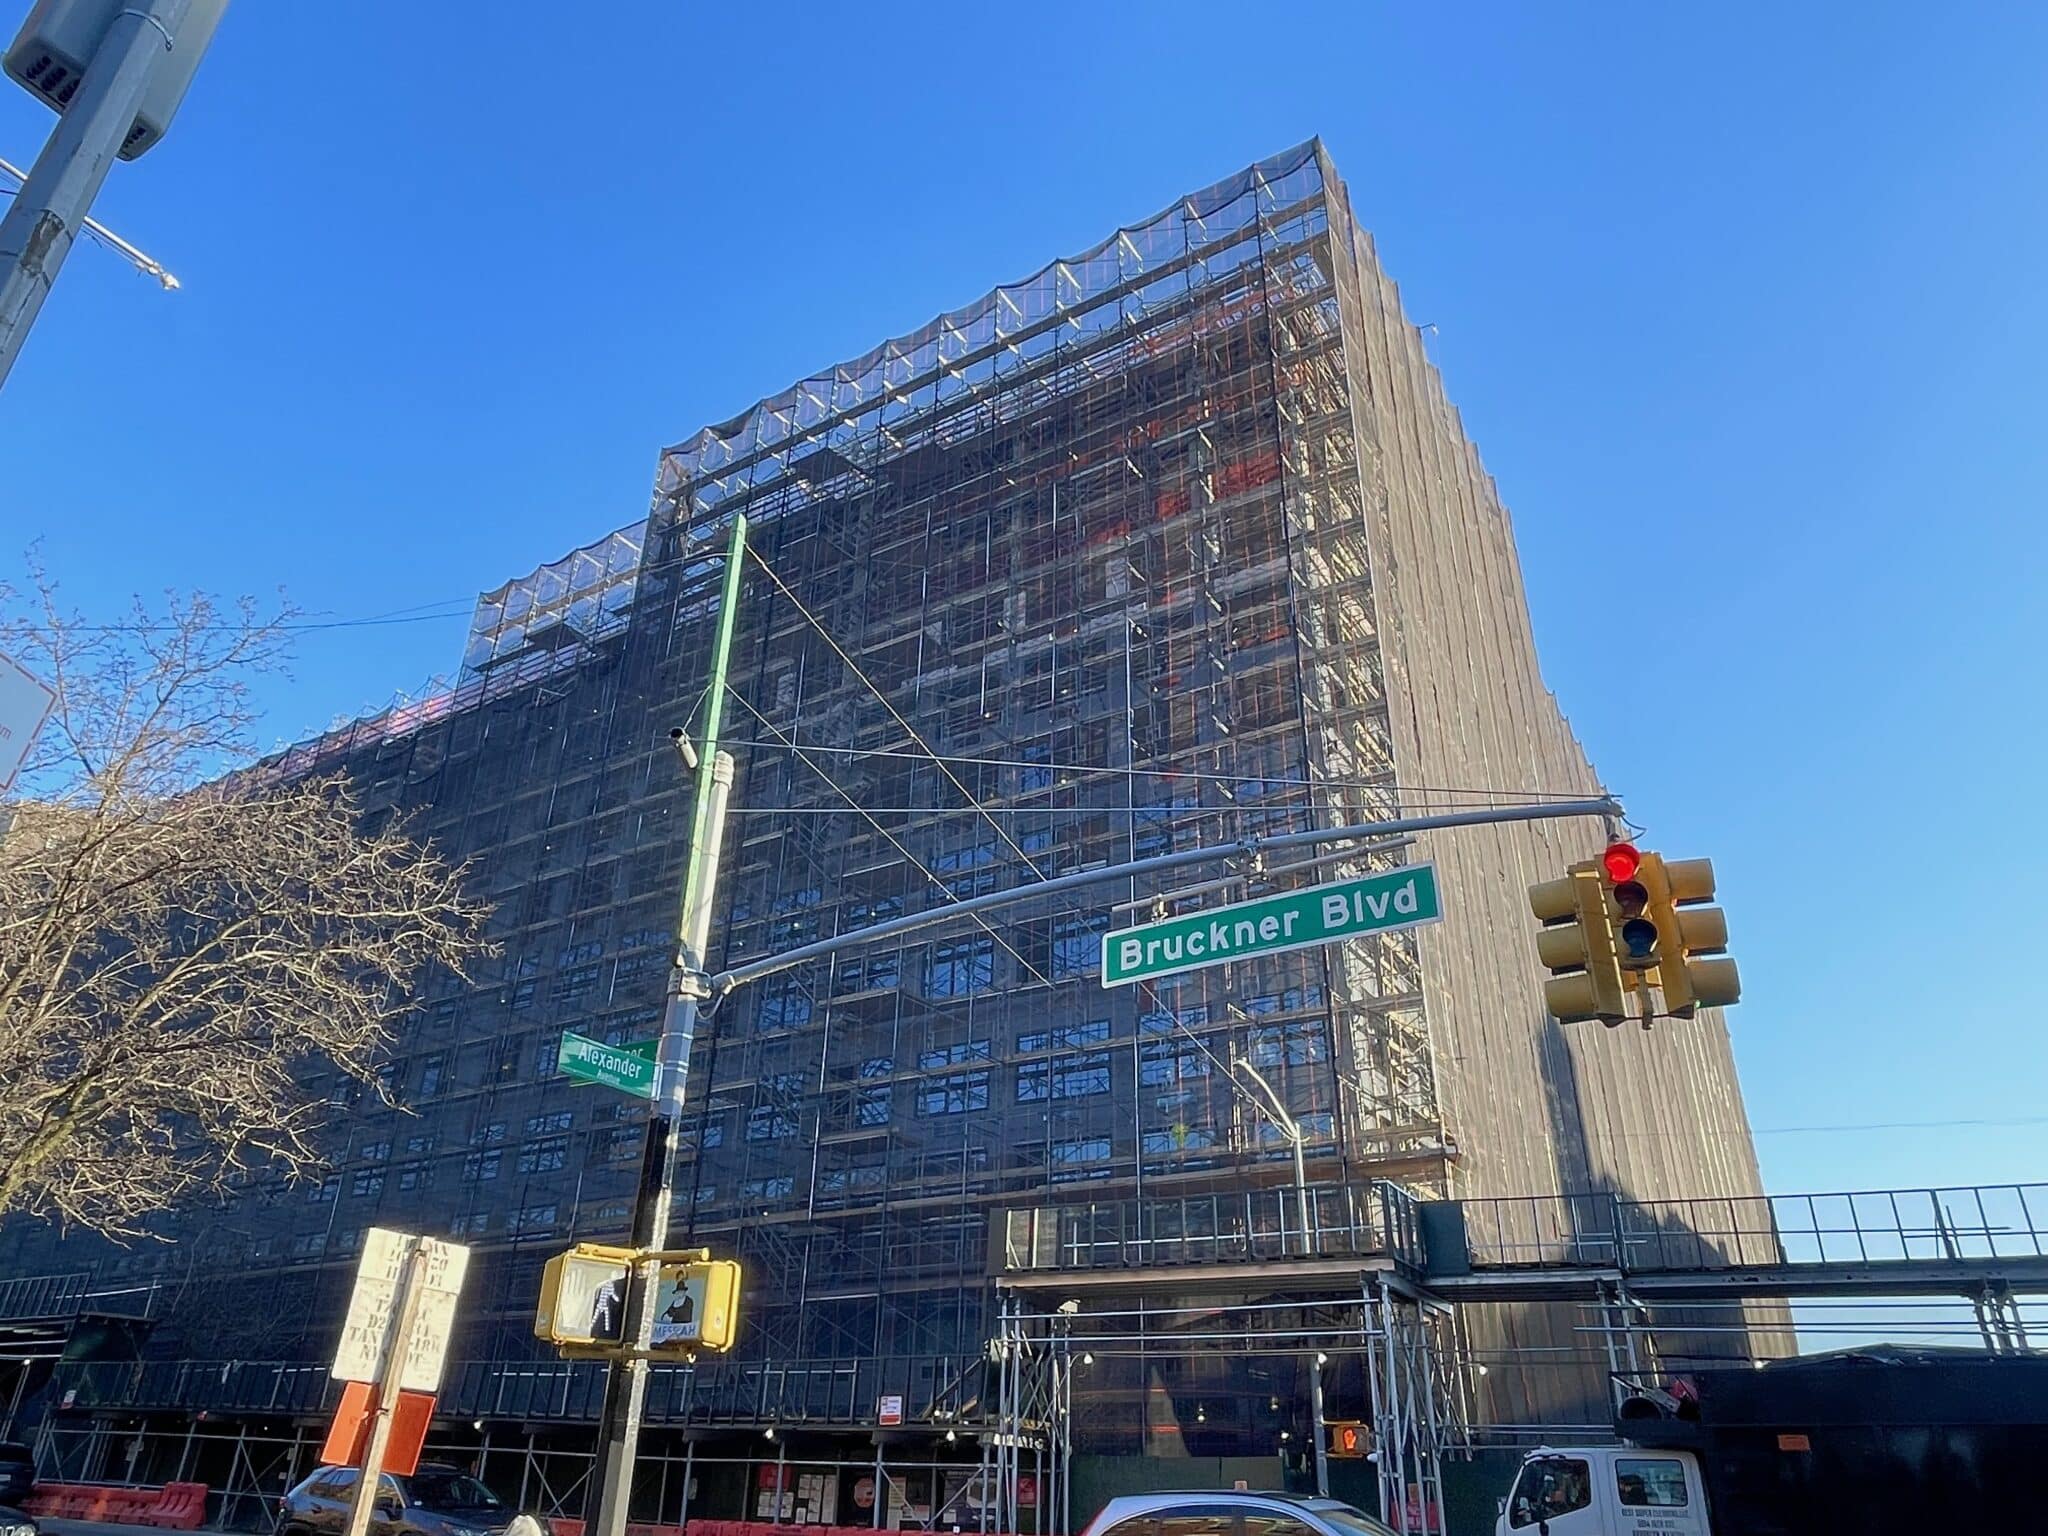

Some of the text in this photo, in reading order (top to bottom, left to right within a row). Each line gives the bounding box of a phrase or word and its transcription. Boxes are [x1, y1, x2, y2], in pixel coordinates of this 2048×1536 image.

[1120, 878, 1418, 971] Bruckner Blvd
[577, 1042, 642, 1079] Alexander
